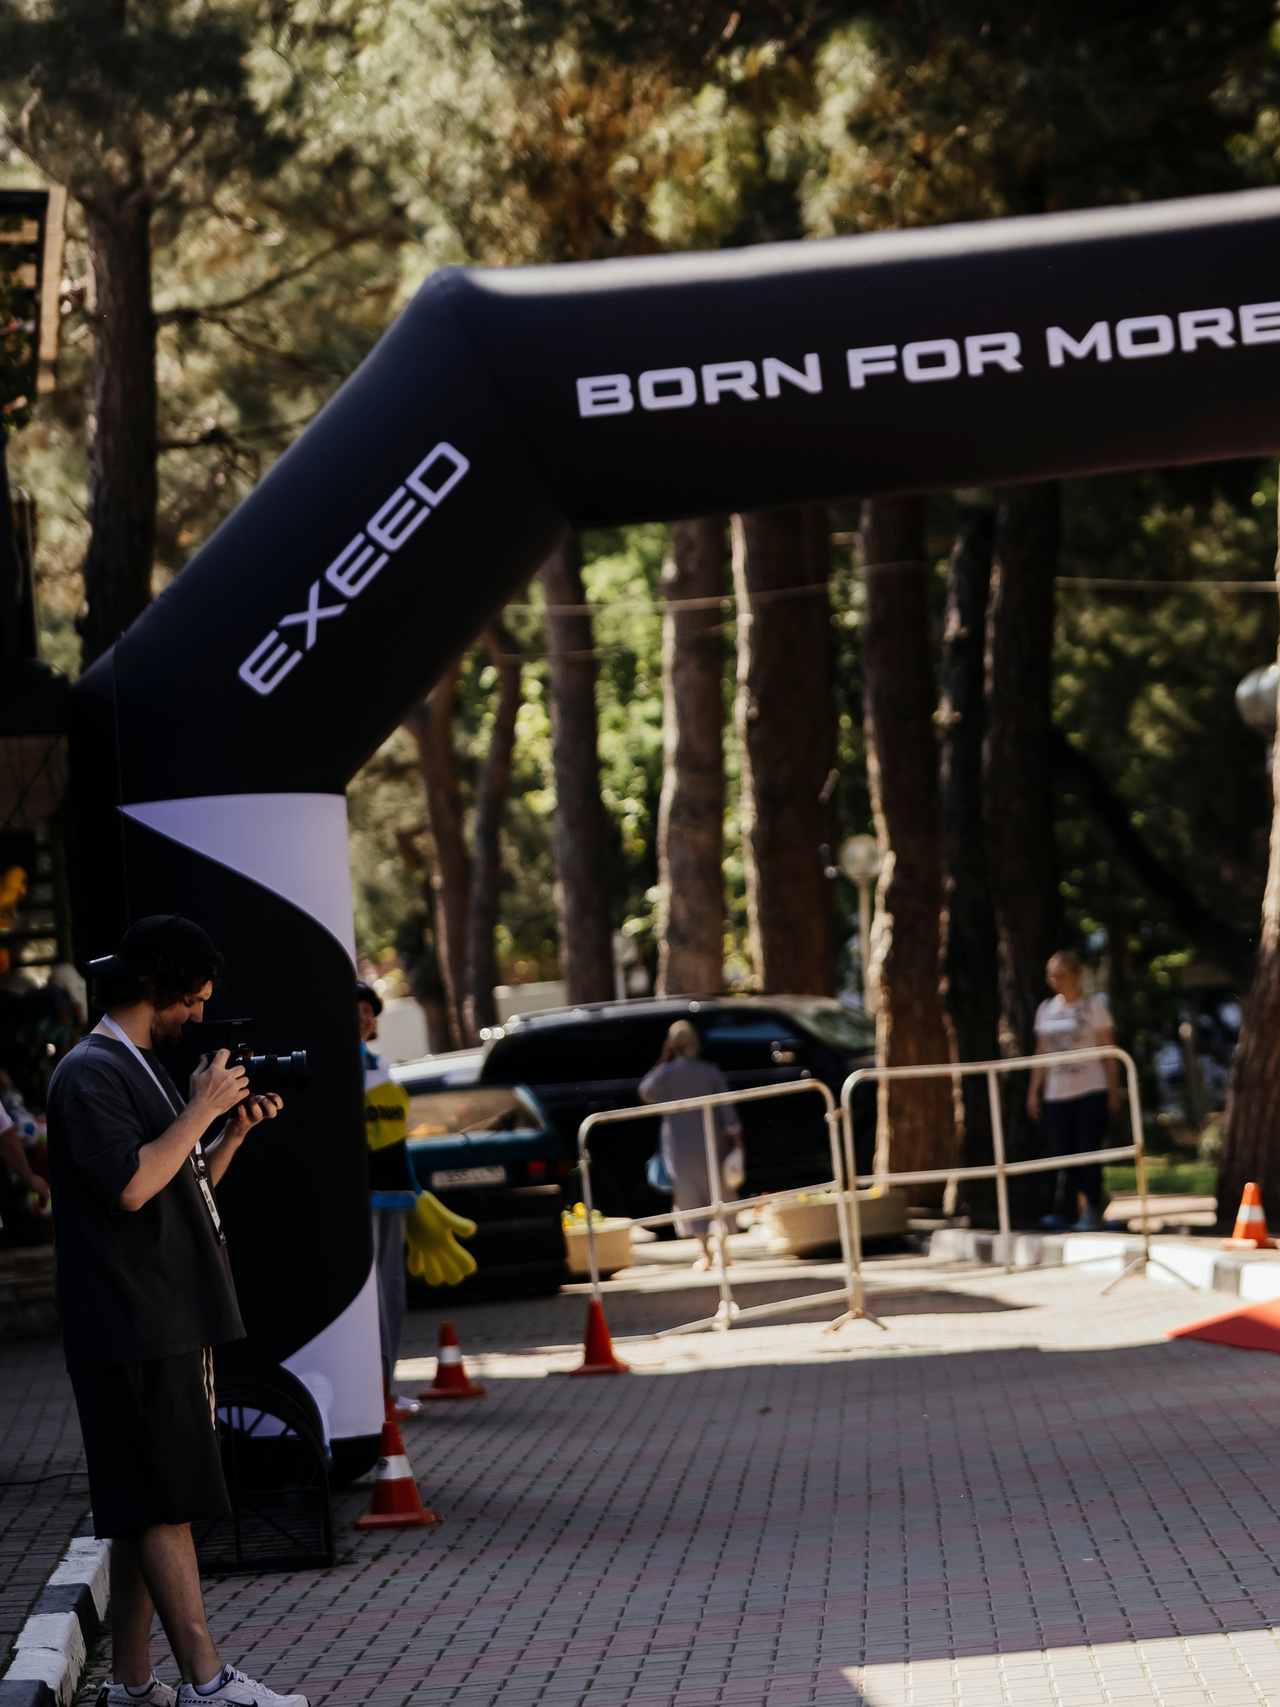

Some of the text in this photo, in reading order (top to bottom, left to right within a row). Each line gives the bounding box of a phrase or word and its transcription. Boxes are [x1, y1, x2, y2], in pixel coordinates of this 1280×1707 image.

[575, 352, 823, 418] BORN
[846, 331, 1024, 390] FOR
[238, 441, 471, 695] EXEED
